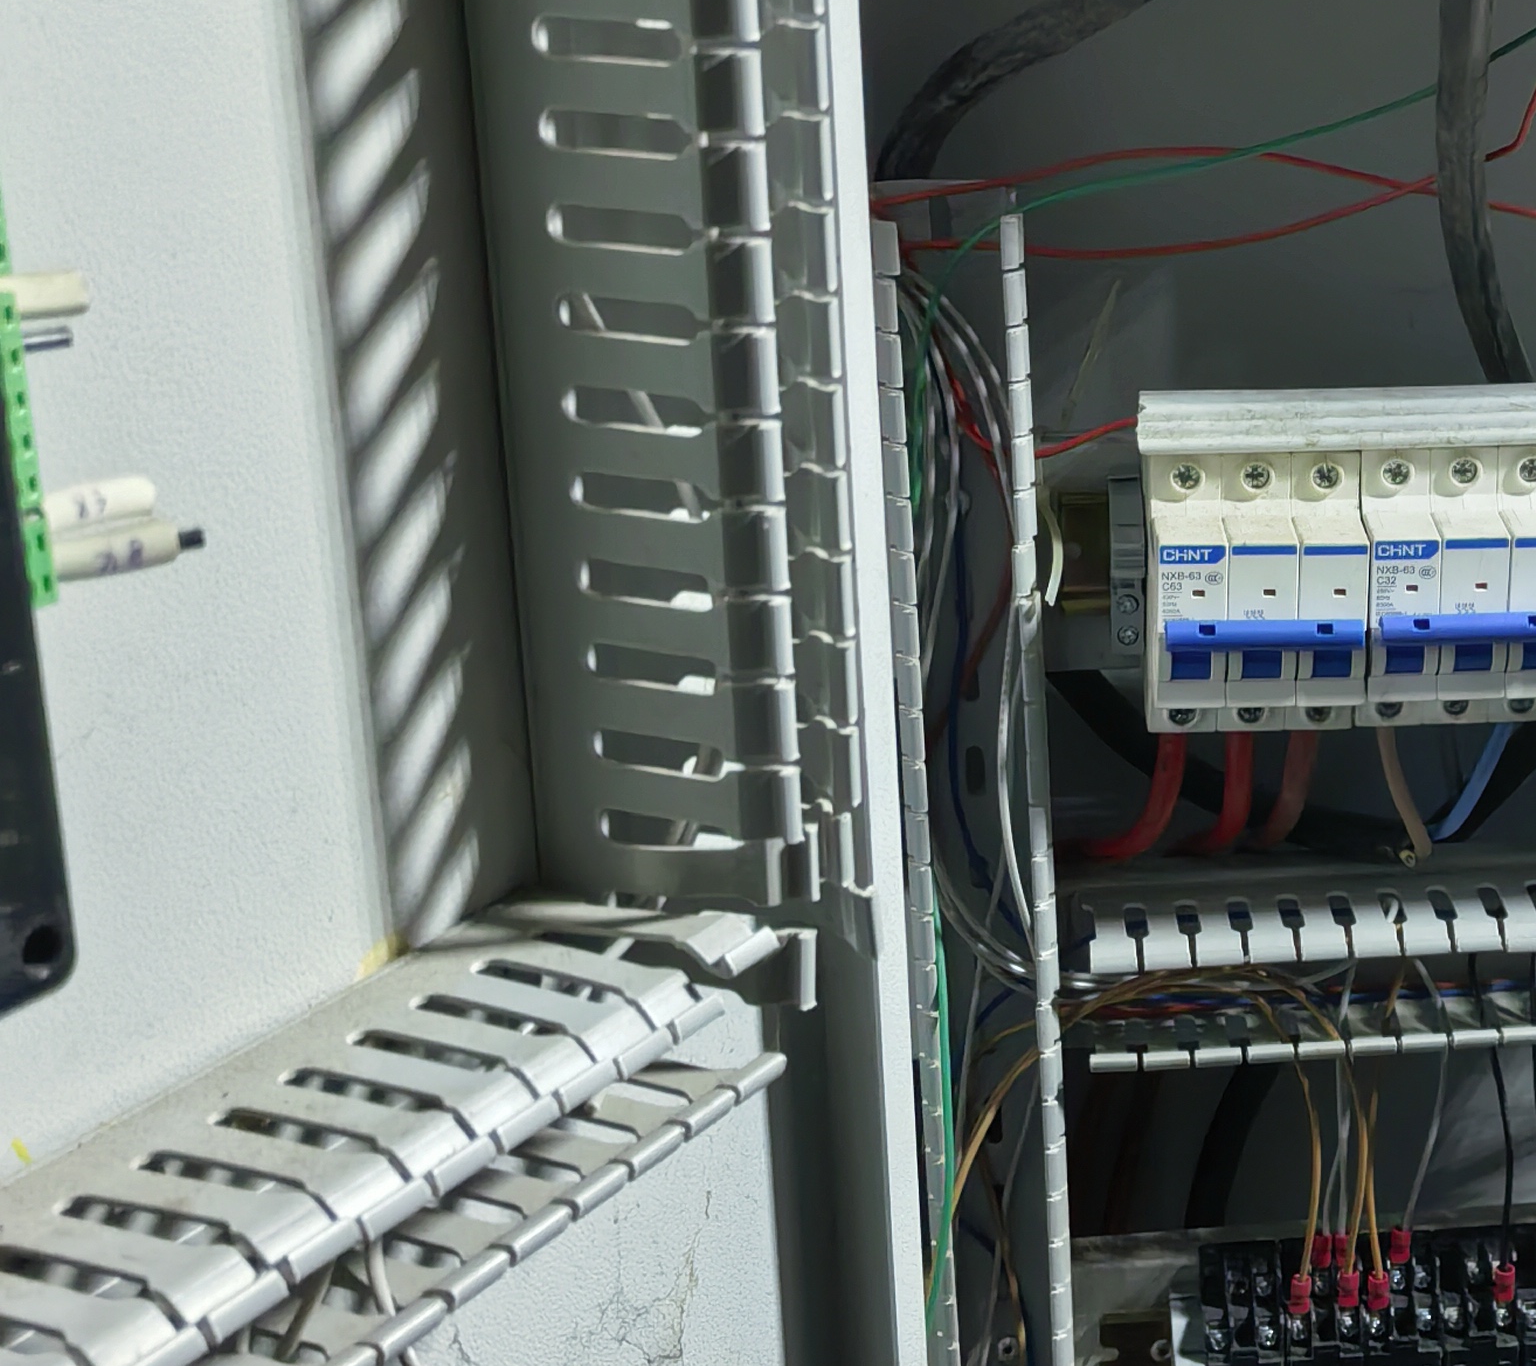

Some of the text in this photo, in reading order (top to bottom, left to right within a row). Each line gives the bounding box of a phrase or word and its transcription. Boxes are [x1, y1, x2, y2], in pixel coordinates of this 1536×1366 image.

[1376, 565, 1416, 575] NXB-63
[1161, 571, 1202, 581] NXB-63
[1376, 576, 1397, 585] C32
[1162, 582, 1183, 591] C63
